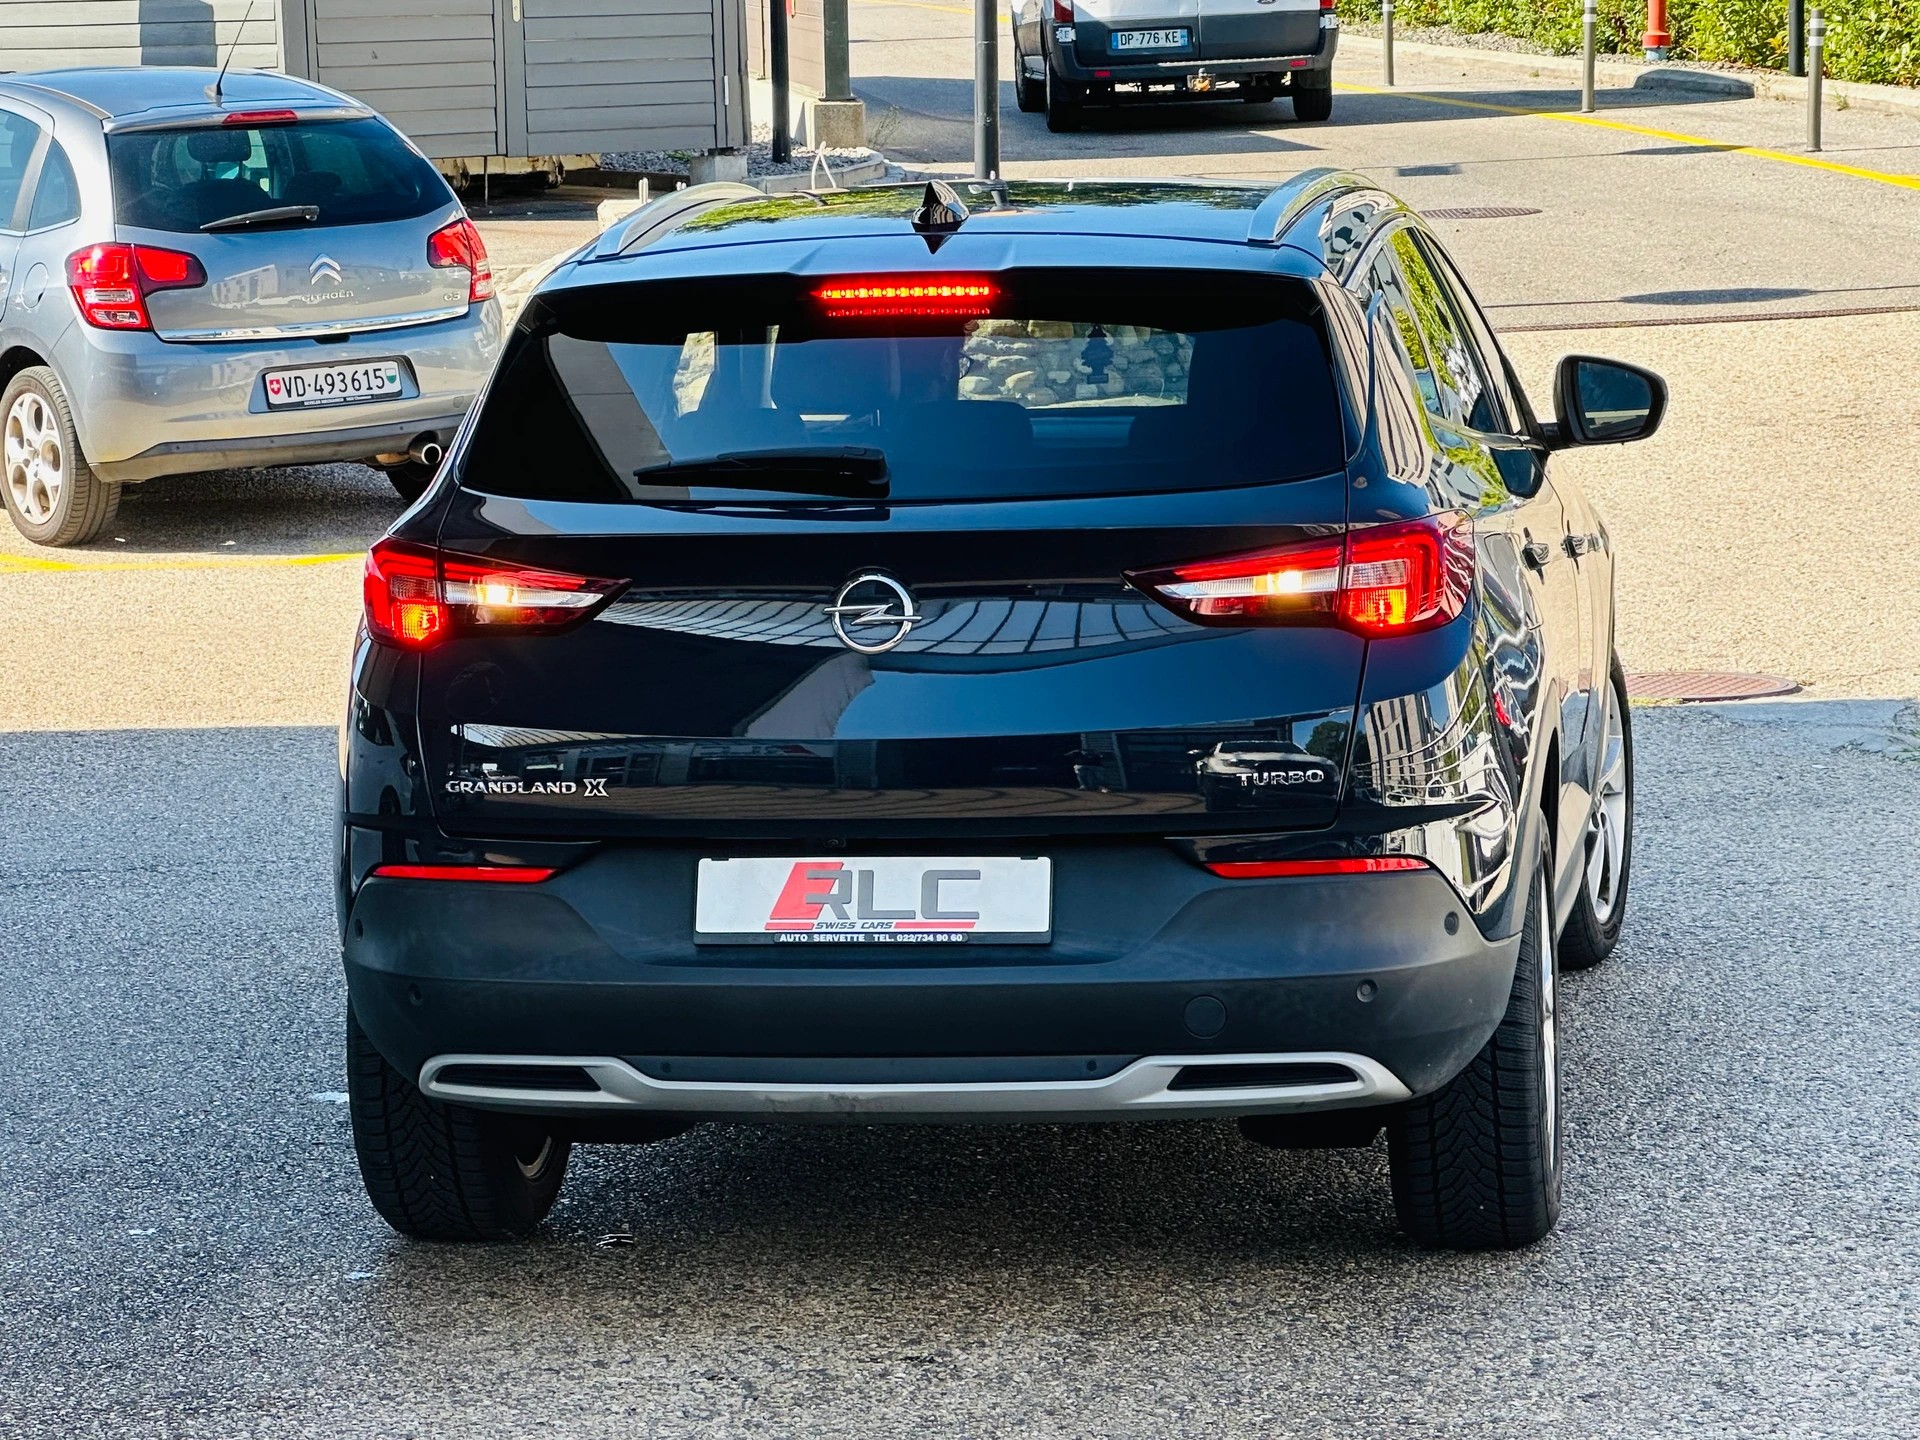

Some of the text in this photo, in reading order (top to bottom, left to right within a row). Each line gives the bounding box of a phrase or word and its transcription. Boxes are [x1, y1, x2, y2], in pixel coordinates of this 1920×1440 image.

[445, 777, 609, 797] GRANDLAND X
[1236, 769, 1324, 787] TURBO
[805, 869, 981, 920] RLC
[815, 921, 894, 930] SWISS CARS
[780, 933, 963, 943] AUTO SERVETTE TEL. 022/734 90 60
